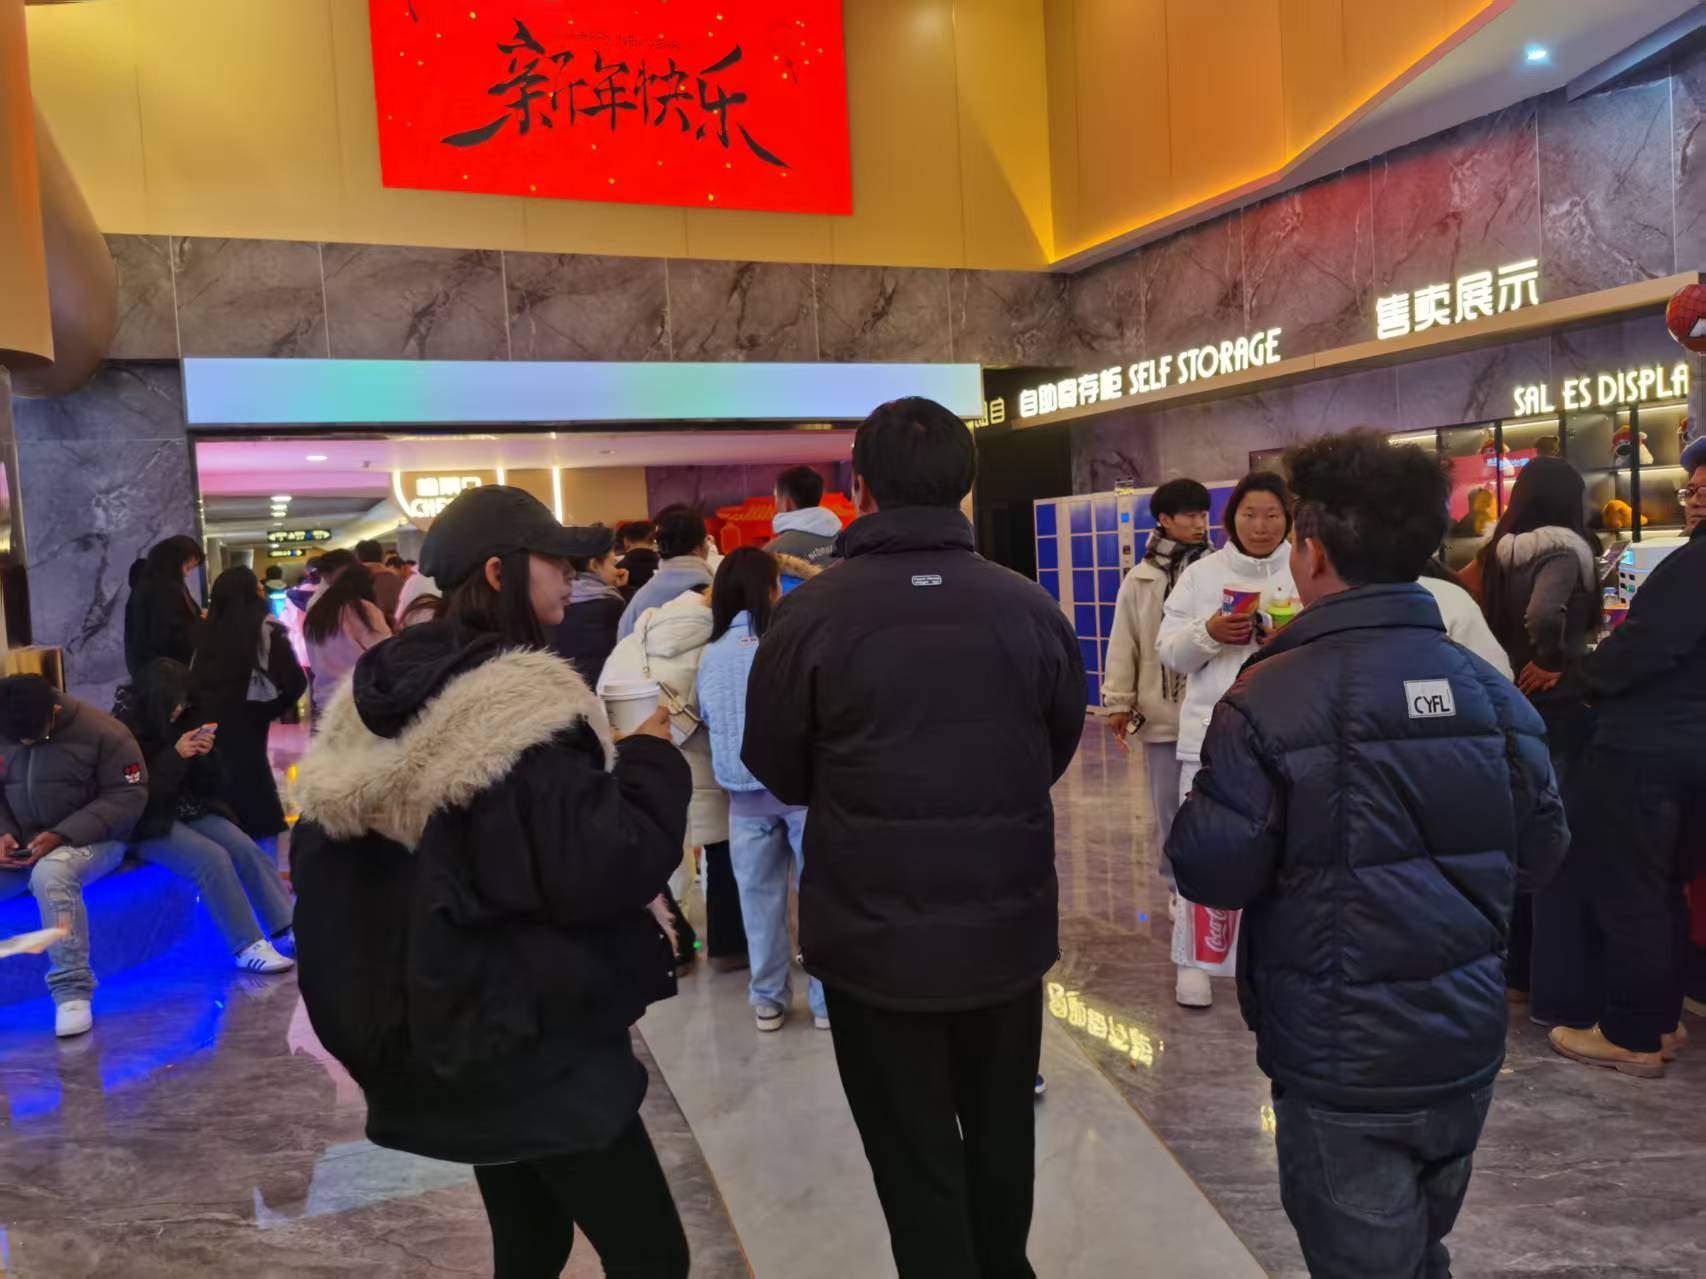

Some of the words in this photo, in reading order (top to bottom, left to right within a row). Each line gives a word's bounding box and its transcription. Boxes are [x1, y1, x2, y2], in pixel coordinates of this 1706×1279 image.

[440, 17, 792, 169] 新年快乐
[1376, 259, 1540, 341] 售卖展示
[1128, 355, 1173, 395] SELF
[1177, 327, 1282, 385] STORAGE
[1413, 694, 1451, 714] CYFL
